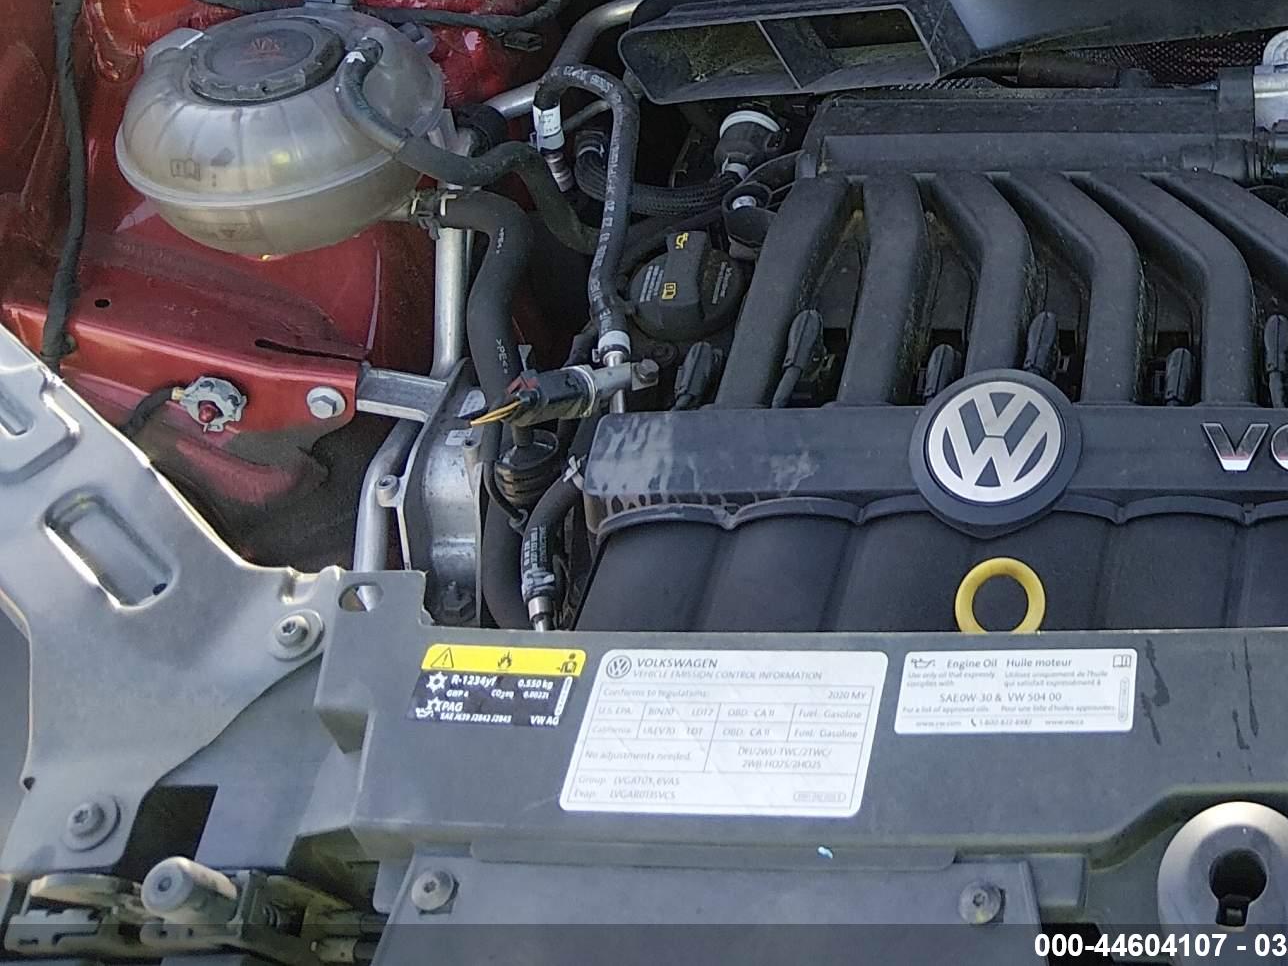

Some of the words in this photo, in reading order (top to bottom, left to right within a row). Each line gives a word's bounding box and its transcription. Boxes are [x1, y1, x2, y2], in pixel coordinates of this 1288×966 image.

[637, 658, 718, 668] VOLKSWAGEN
[946, 658, 981, 670] Engine
[983, 658, 997, 668] Oil
[1006, 658, 1032, 667] Huile
[1035, 659, 1072, 667] moteur
[633, 670, 667, 678] VEHICLE
[670, 670, 713, 678] EMISSION
[715, 670, 756, 679] CONTROL
[758, 671, 822, 680] INFORMATION
[452, 675, 497, 688] R-1234yf
[518, 679, 542, 688] 0.550
[542, 680, 553, 690] kg
[828, 690, 849, 699] 2020
[851, 691, 866, 699] MY
[995, 693, 1002, 702] &
[1008, 692, 1025, 701] VW
[1028, 692, 1046, 701] 504
[1049, 692, 1062, 701] 00
[441, 702, 463, 712] PAG
[754, 708, 768, 717] CA
[824, 709, 862, 718] Gasoline
[530, 716, 544, 725] VW
[546, 716, 560, 726] AG
[750, 728, 763, 736] CA
[820, 729, 858, 738] Gasoline
